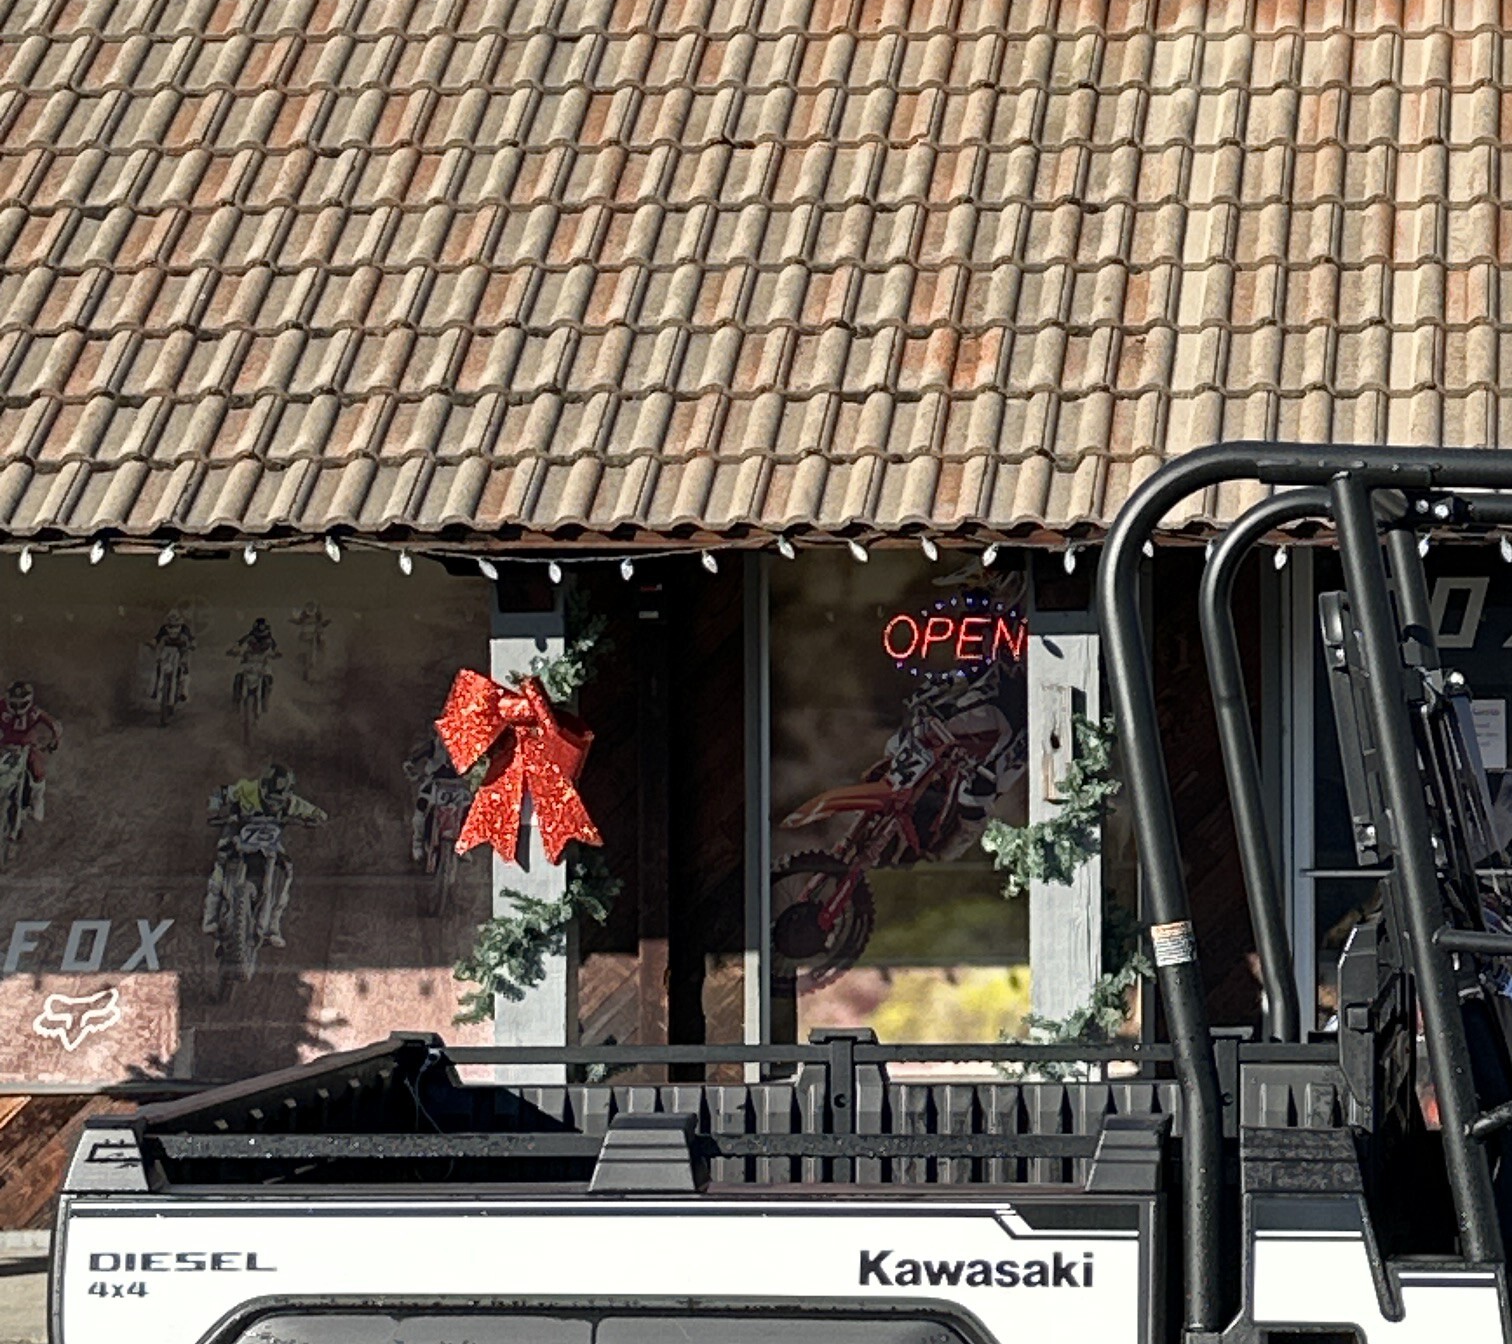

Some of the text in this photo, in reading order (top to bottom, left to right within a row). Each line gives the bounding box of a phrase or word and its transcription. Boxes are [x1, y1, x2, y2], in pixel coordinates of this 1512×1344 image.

[883, 613, 1026, 662] OPEN
[3, 919, 175, 973] FOX
[89, 1252, 278, 1272] DIESEL
[859, 1250, 1094, 1288] Kawasaki
[88, 1281, 149, 1298] 4x4
